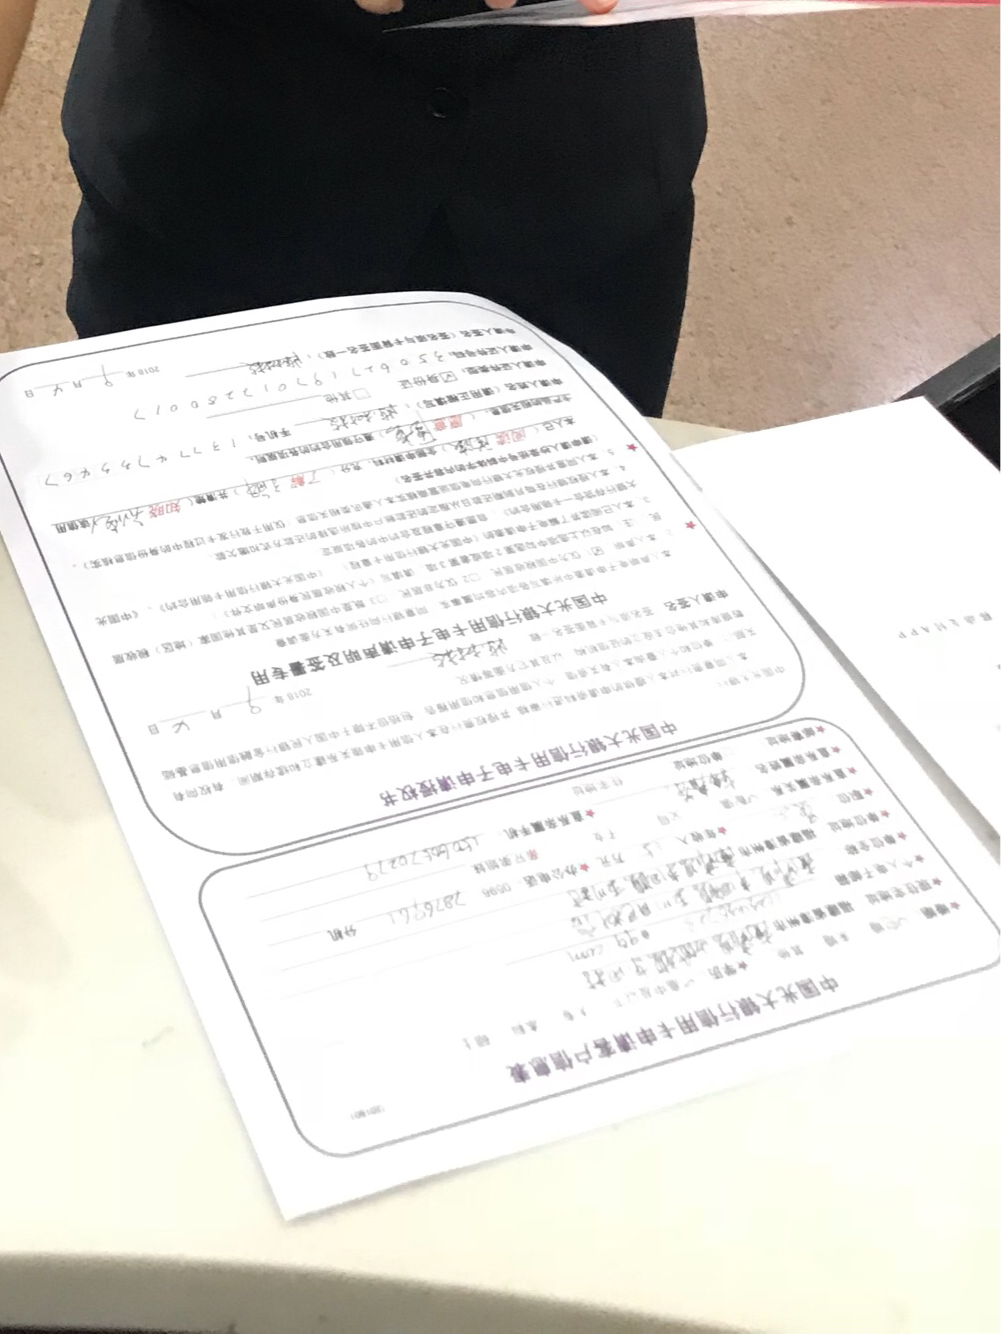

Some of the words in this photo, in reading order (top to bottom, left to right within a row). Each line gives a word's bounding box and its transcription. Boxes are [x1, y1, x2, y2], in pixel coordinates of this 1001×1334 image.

[395, 371, 441, 390] 身份证
[319, 389, 353, 405] 其他
[661, 587, 729, 612] 申请人签名
[248, 590, 609, 687] 中国光大银行信用卡电子申请声明及签署专用
[763, 725, 817, 747] 邮寄地址
[377, 719, 679, 808] 中国光大银行信用卡电子申请授权书
[753, 745, 832, 775] 直系亲属姓名
[768, 766, 848, 797] 直系亲属关系
[501, 808, 585, 841] 直系亲属手机
[521, 862, 579, 889] 办公电话
[325, 922, 358, 943] 分机
[706, 961, 738, 980] 学历
[504, 973, 840, 1084] 中国光大银行信用卡申请客户信息表
